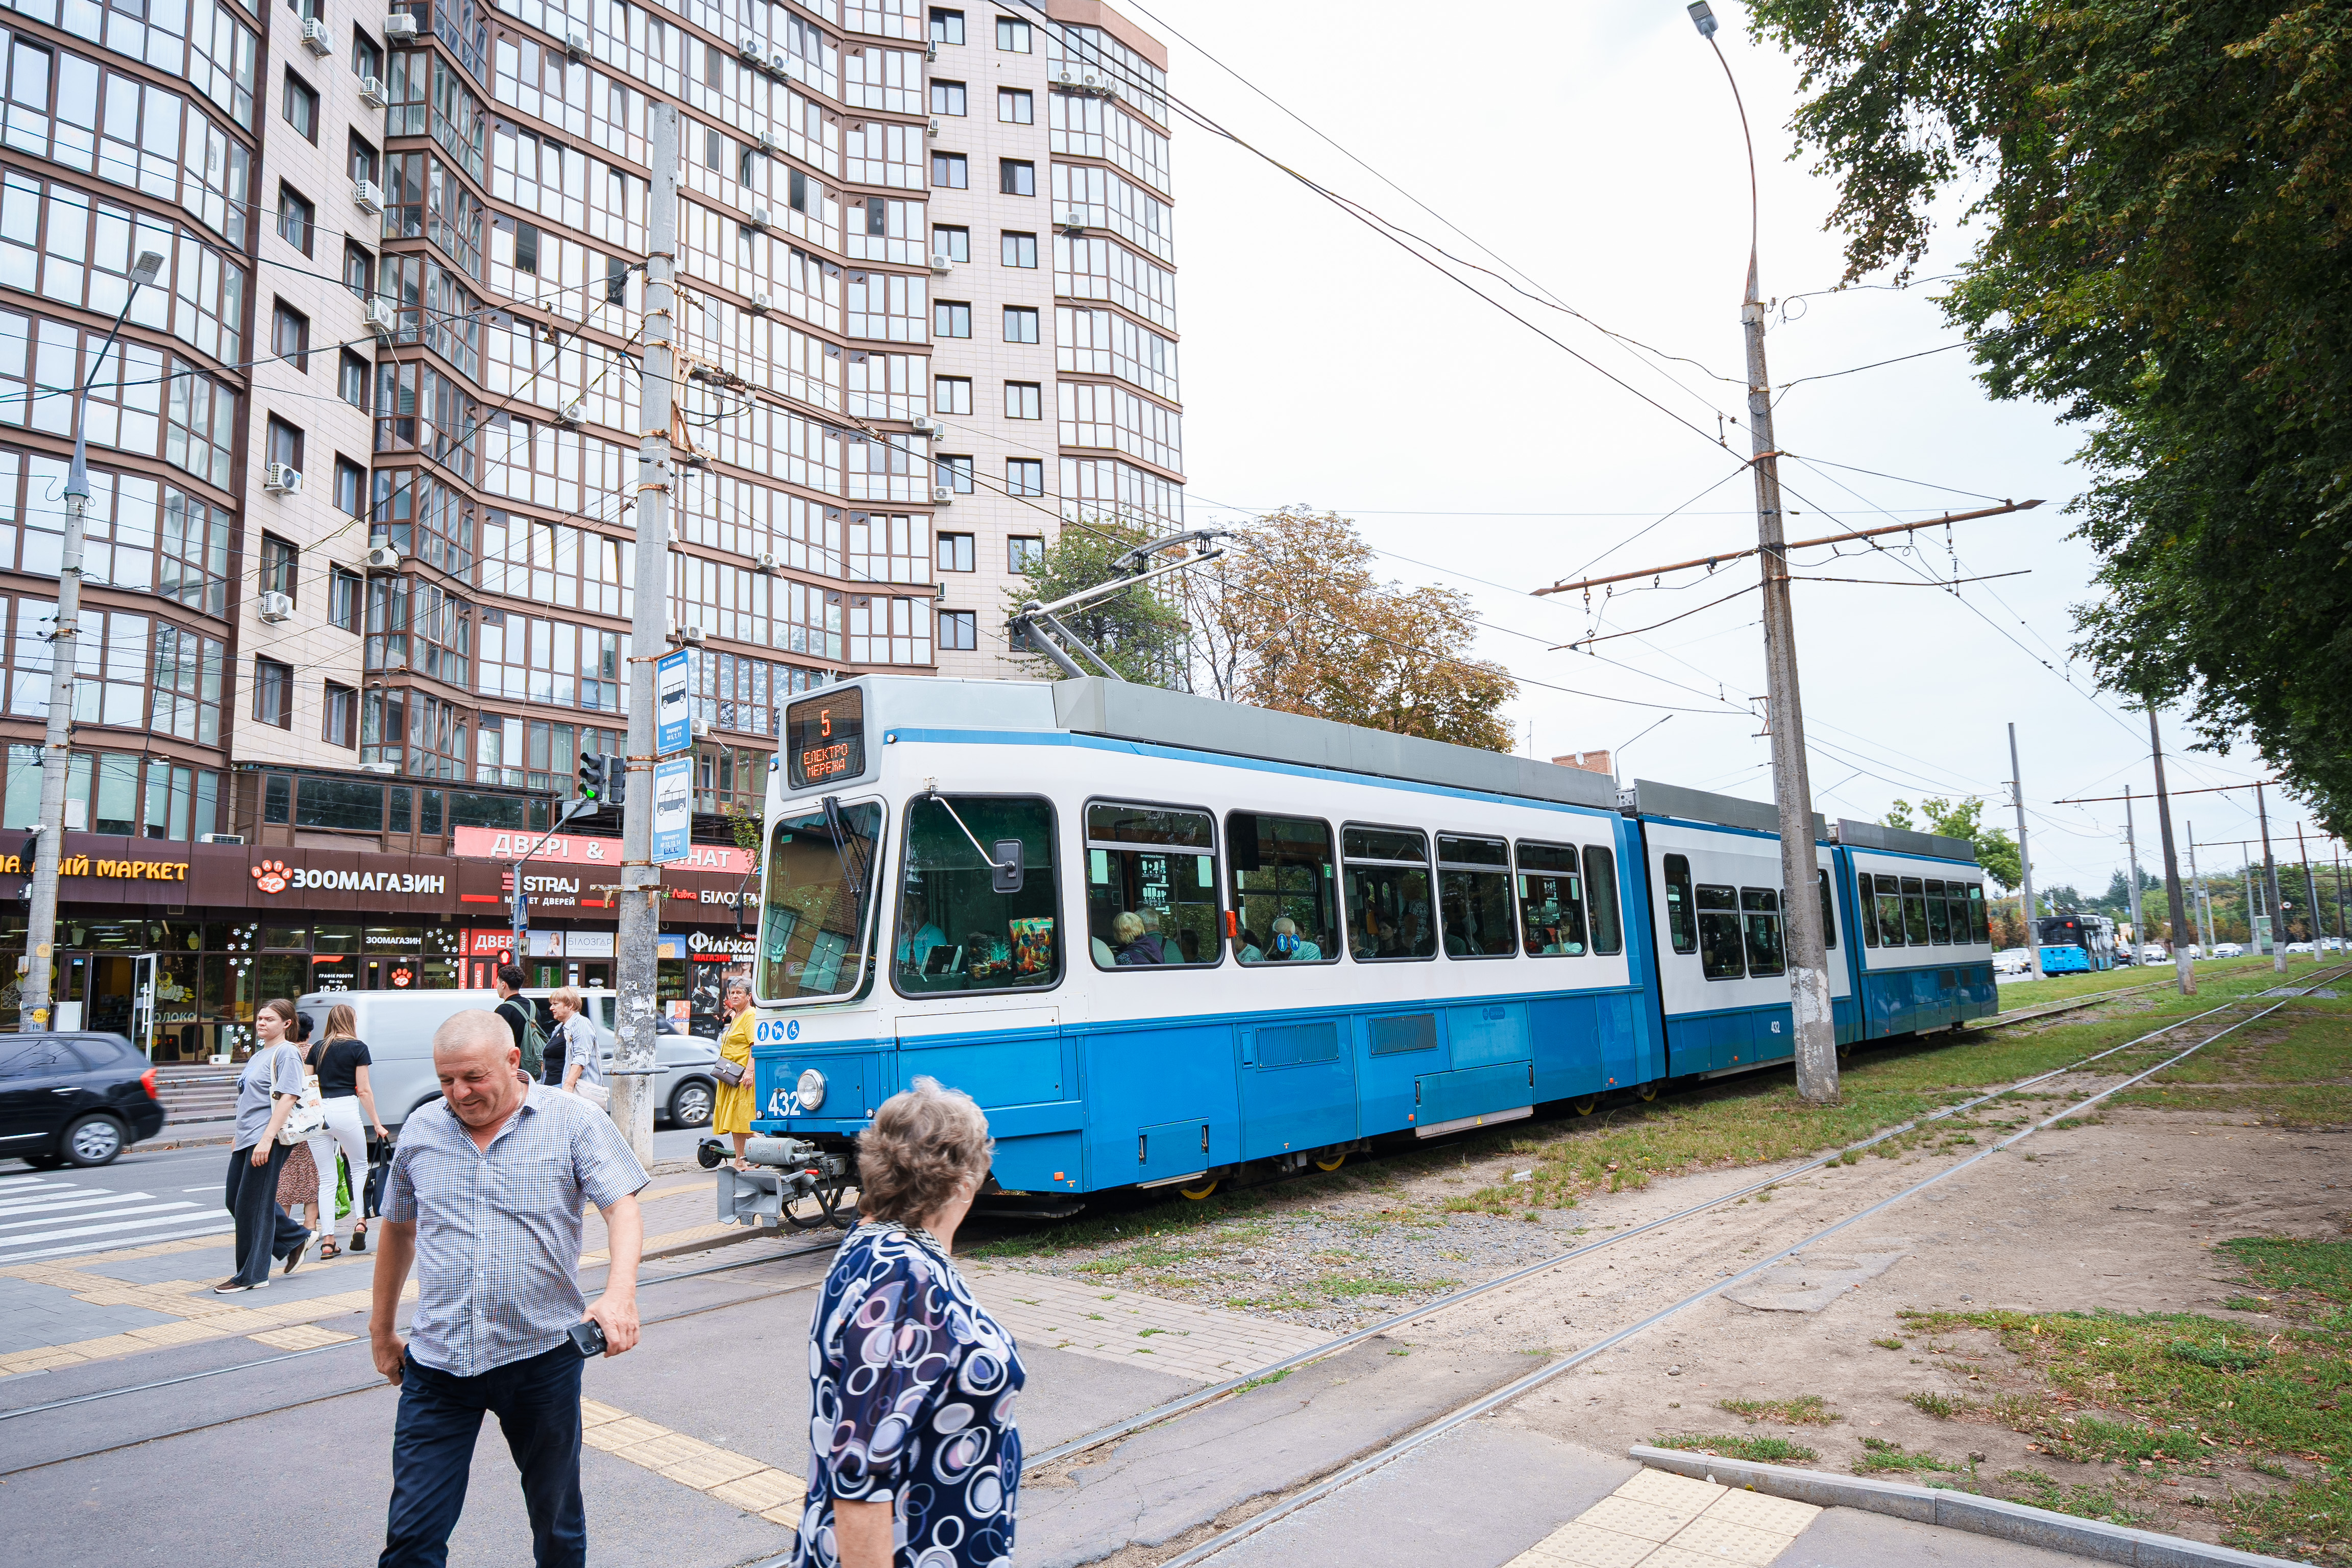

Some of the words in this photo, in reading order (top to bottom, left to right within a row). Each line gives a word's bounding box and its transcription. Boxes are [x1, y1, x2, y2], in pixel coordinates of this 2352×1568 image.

[821, 709, 830, 737] 5
[803, 743, 848, 765] ЕЛЕКТРО
[807, 758, 845, 778] МЕРЕЖА
[491, 834, 569, 857] ДВЕРІ
[586, 841, 604, 860] &
[96, 859, 189, 880] МАРКЕТ
[254, 862, 291, 878] ЛАПА
[291, 868, 445, 894] ЗООМАГАЗИН
[523, 876, 580, 893] STRAJ
[504, 896, 538, 904] МЕТ
[543, 897, 575, 906] ДВЕРЕЙ
[366, 936, 422, 945] ЗООМАГАЗИН
[475, 935, 513, 950] ДВЕР
[568, 937, 612, 946] БІЛОЗГАР
[688, 930, 756, 953] Філіжа
[1771, 1021, 1780, 1033] 432
[768, 1091, 800, 1116] 432
